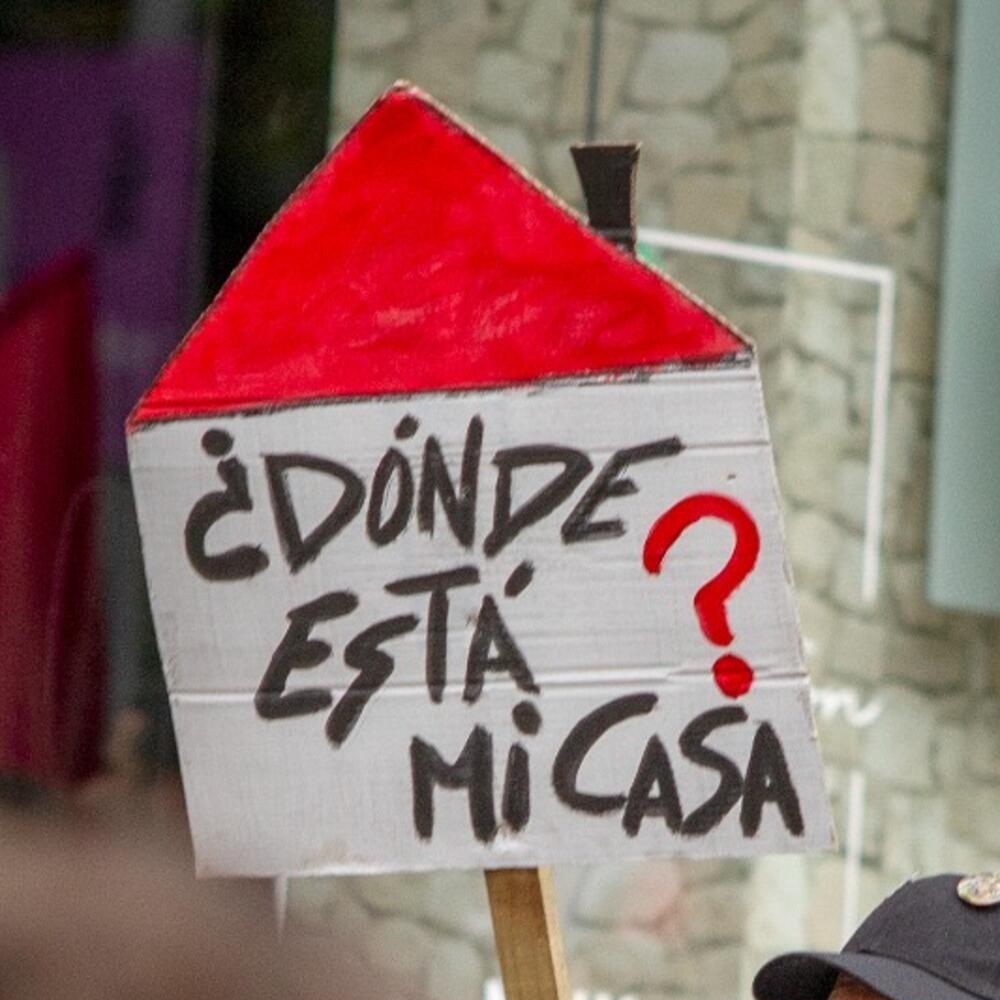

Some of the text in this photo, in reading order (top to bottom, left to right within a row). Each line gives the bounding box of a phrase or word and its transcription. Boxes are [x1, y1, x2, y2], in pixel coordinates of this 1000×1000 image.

[183, 414, 687, 583] ¿DÓNDE
[253, 560, 542, 750] ESTÁ
[551, 692, 806, 840] CASA
